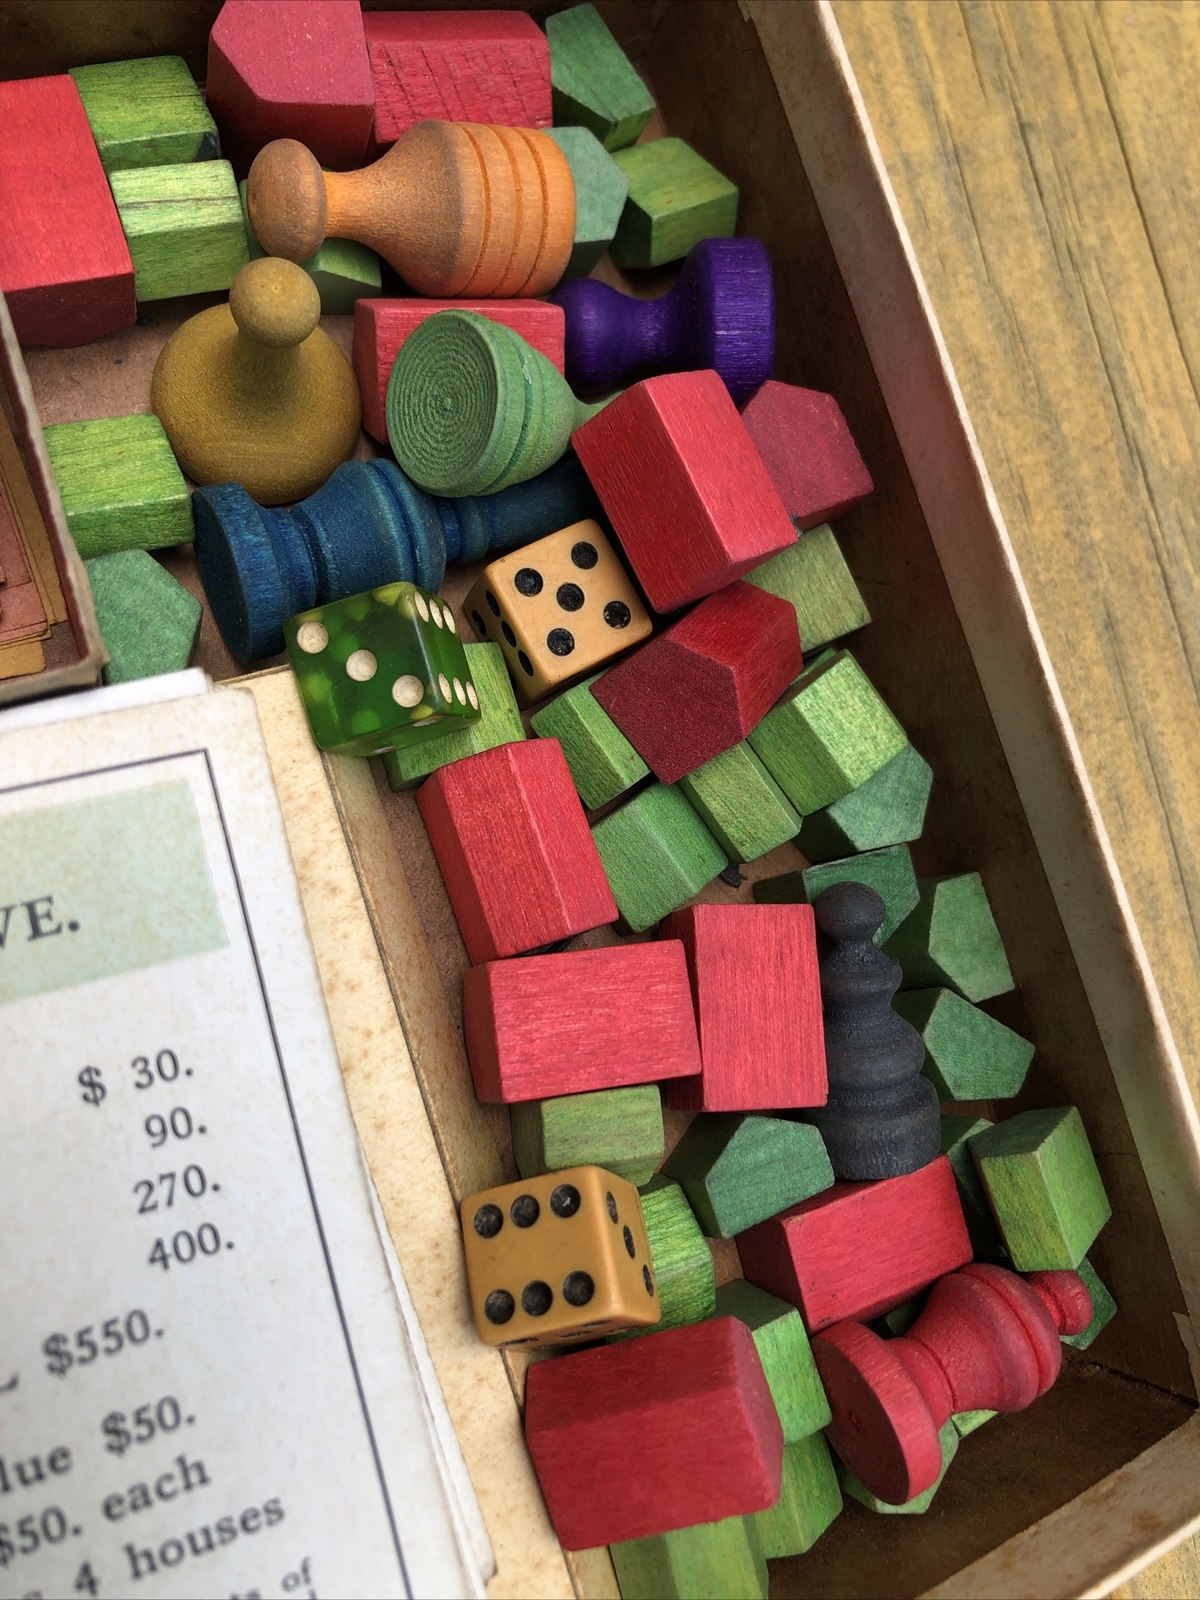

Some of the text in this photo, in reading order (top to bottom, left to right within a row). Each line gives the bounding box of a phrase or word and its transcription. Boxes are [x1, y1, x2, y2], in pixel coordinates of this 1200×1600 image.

[130, 1048, 194, 1091] 30.
[144, 1106, 208, 1149] 90.
[133, 1164, 222, 1215] 270.
[147, 1222, 235, 1271] 400.
[42, 1308, 165, 1378] $550.
[102, 1396, 195, 1457] $50.
[102, 1453, 211, 1523] each
[74, 1497, 286, 1598] 4 houses
[281, 1556, 312, 1593] of
